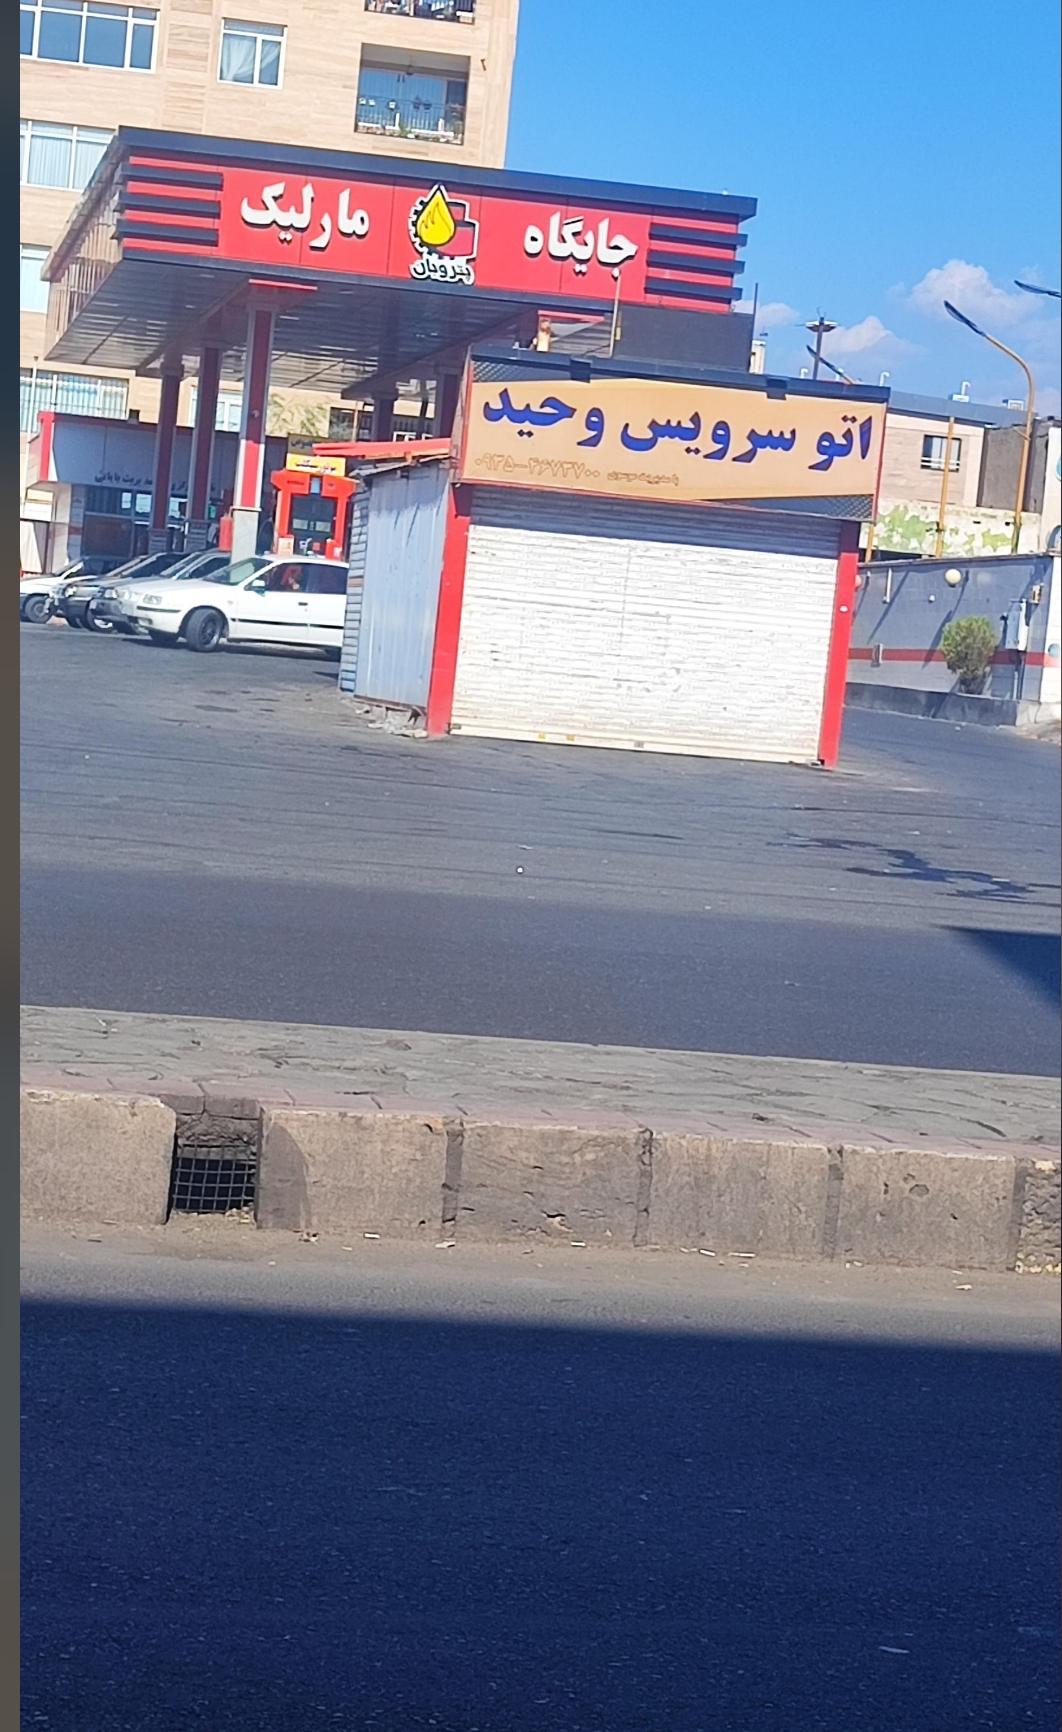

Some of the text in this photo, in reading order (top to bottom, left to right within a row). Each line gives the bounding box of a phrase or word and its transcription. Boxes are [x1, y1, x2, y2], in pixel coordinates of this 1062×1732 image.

[240, 181, 639, 282] جایگاه مارلیک
[482, 387, 873, 472] اتو سرویس وحید
